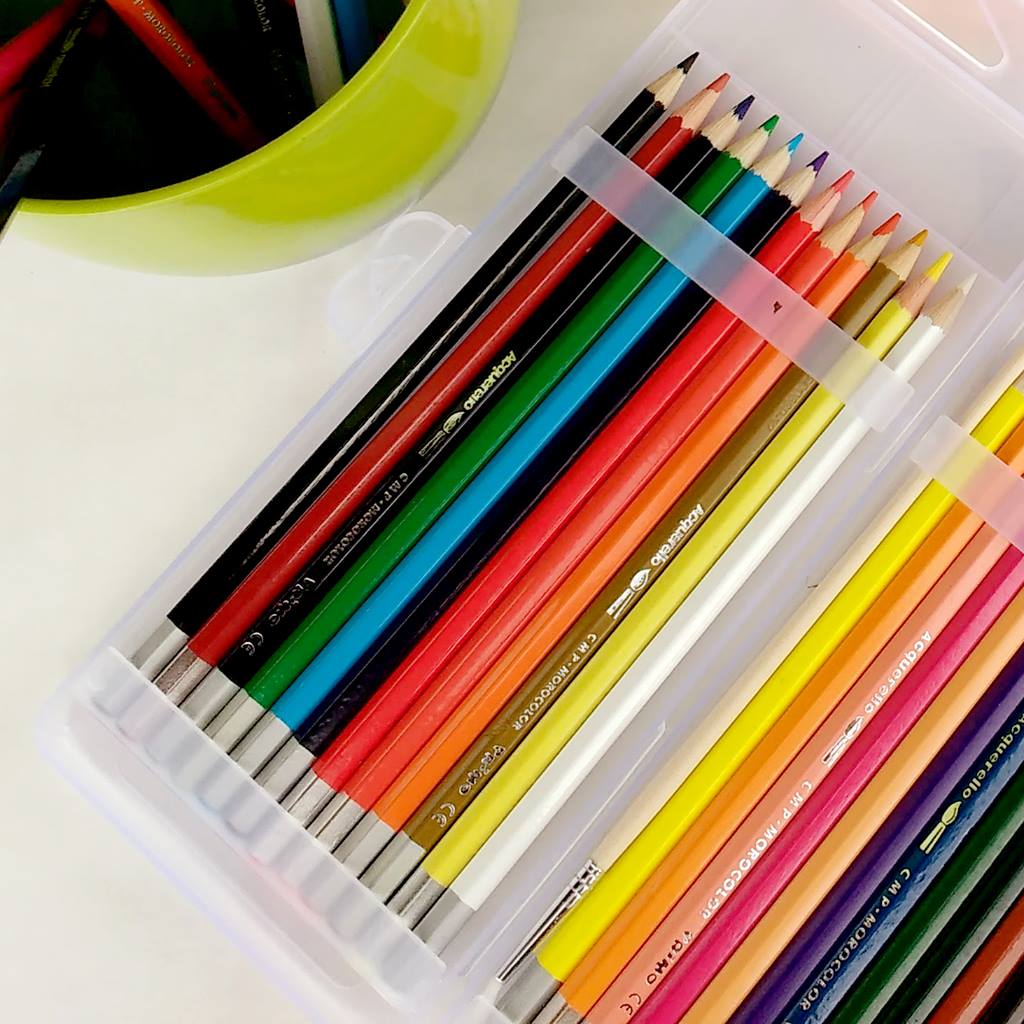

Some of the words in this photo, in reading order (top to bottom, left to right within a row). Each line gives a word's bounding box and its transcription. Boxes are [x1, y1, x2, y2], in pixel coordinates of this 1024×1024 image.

[464, 350, 517, 411] Acquerello
[651, 503, 706, 567] Acquerello
[864, 630, 933, 715] Acquerello
